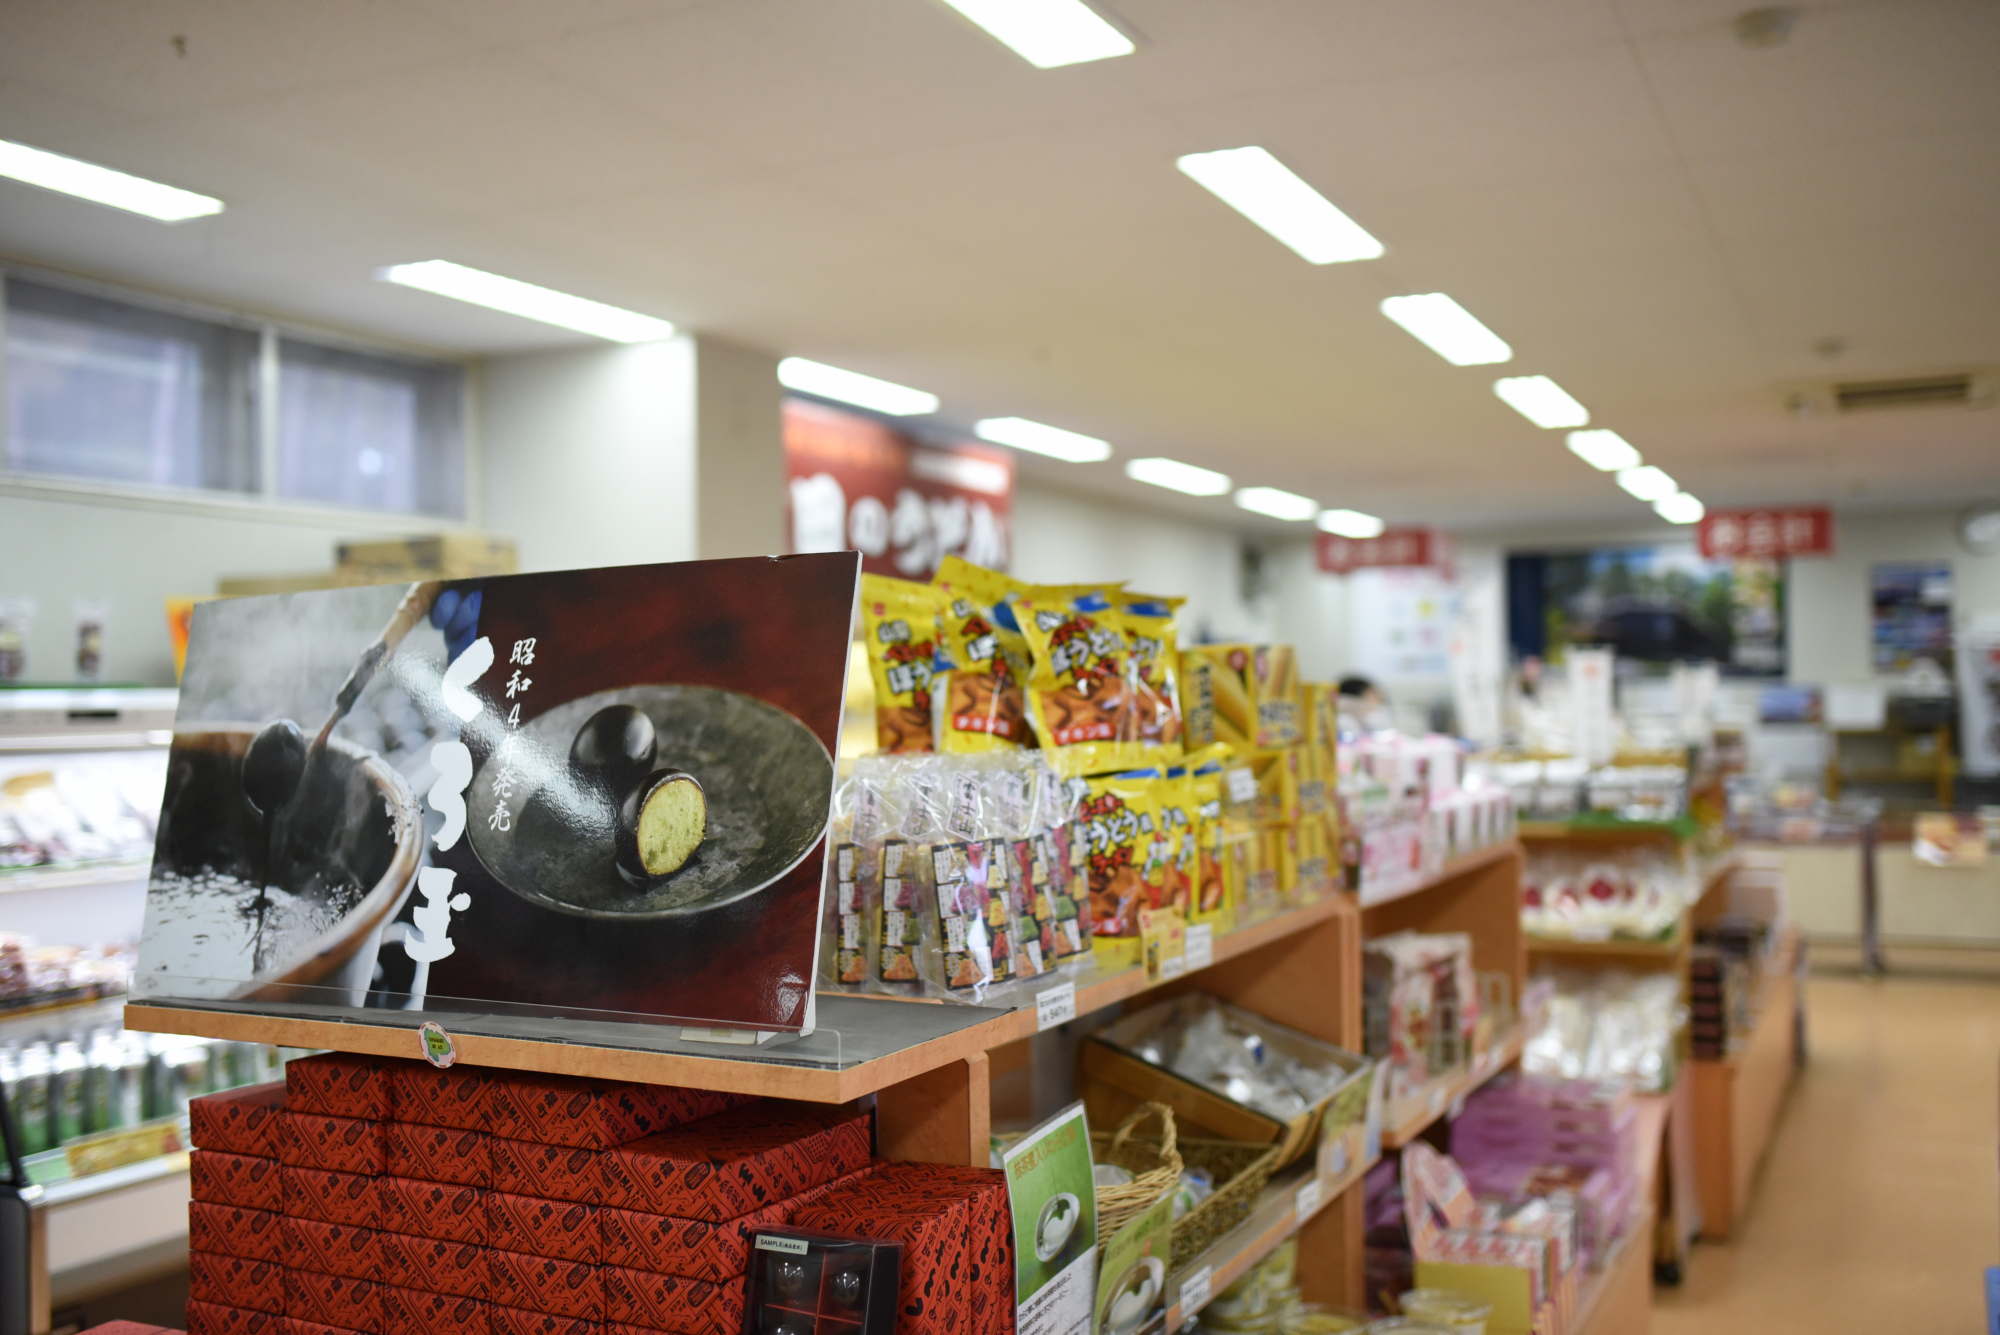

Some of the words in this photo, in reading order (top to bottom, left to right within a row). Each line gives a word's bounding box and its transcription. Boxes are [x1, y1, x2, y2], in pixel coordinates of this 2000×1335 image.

[404, 636, 495, 963] くろ玉
[488, 636, 537, 832] 昭和4年発売
